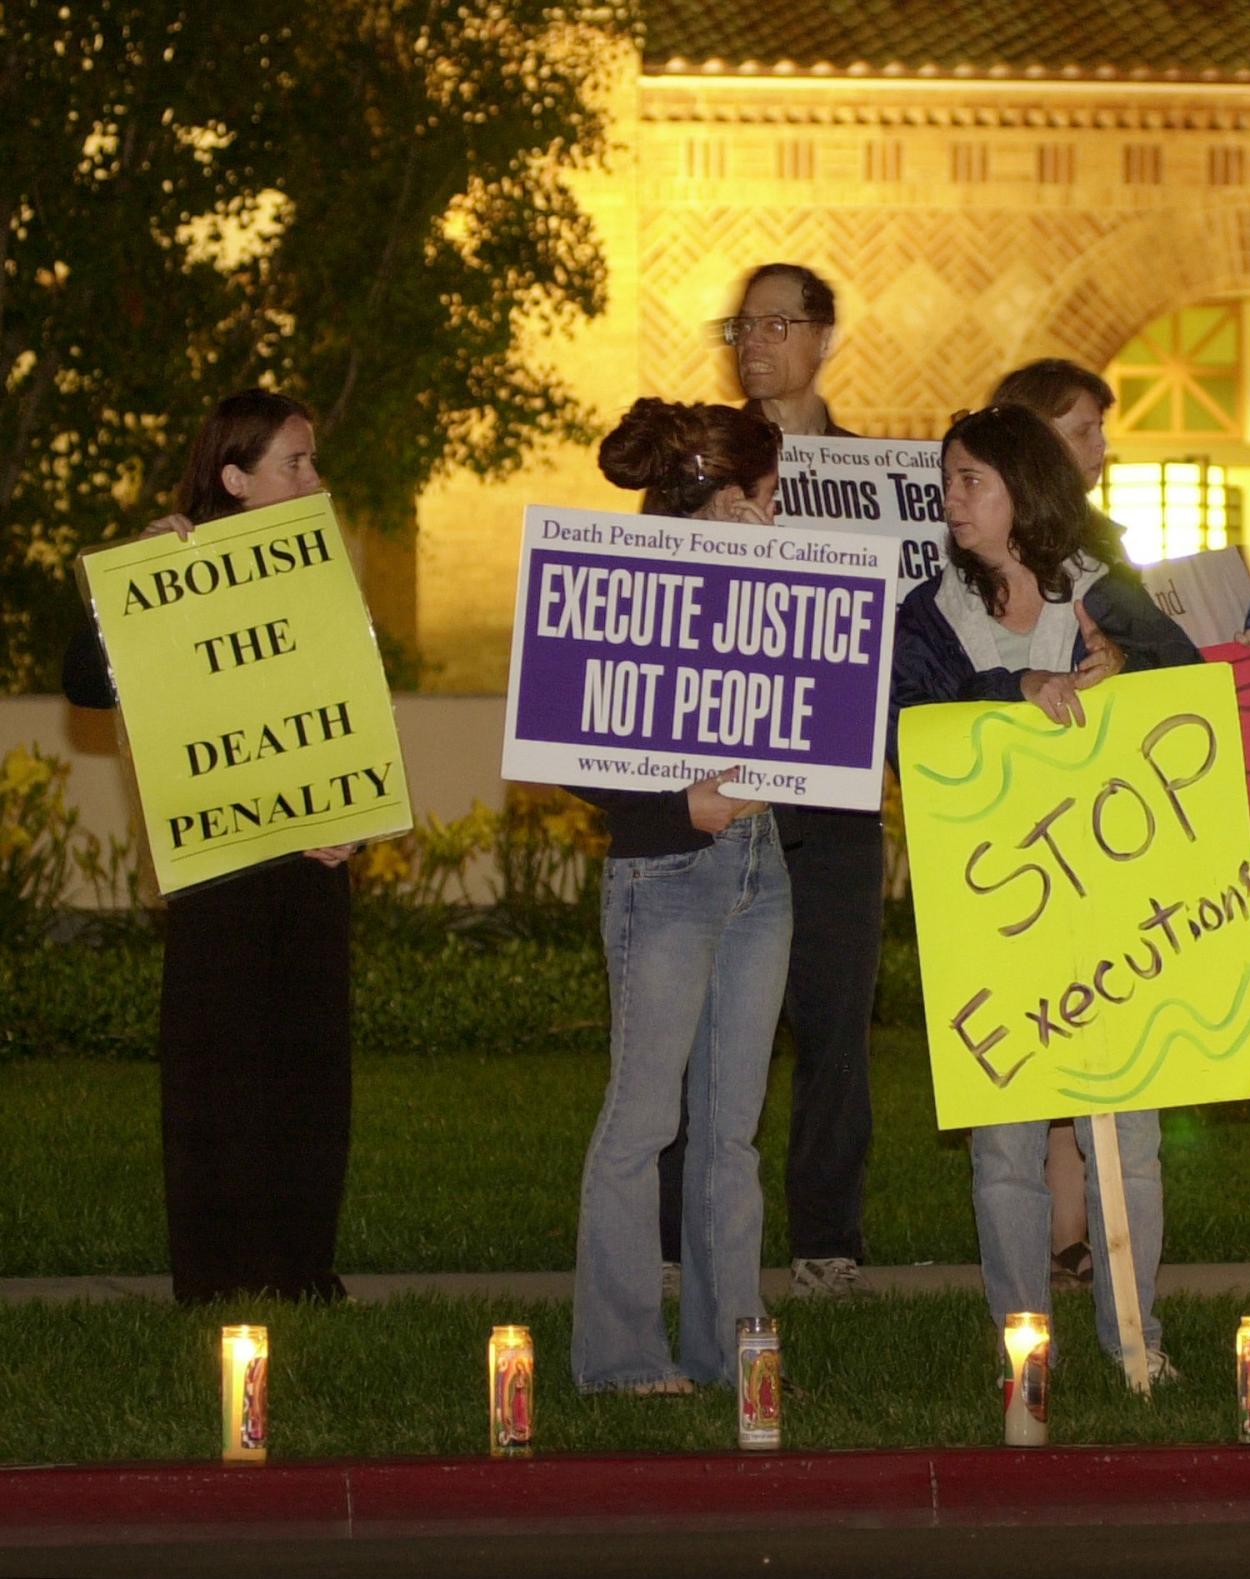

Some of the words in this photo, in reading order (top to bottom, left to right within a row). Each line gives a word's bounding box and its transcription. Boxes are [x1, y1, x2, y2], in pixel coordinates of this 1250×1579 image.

[773, 470, 881, 520] utions
[887, 472, 944, 522] Tea
[820, 447, 870, 466] Focus
[874, 449, 896, 468] of
[122, 527, 334, 617] ABOLISH
[542, 519, 603, 545] Death
[609, 525, 685, 557] Penalty
[689, 533, 748, 557] Focus
[753, 536, 778, 559] of
[779, 541, 878, 568] California
[194, 618, 297, 675] THE
[537, 562, 704, 650] EXECUTE
[712, 579, 874, 665] JUSTICE
[183, 701, 356, 778] DEATH
[581, 658, 665, 738] NOT
[671, 666, 815, 752] PEOPLE
[168, 762, 392, 849] PENALTY
[963, 711, 1217, 938] STOP
